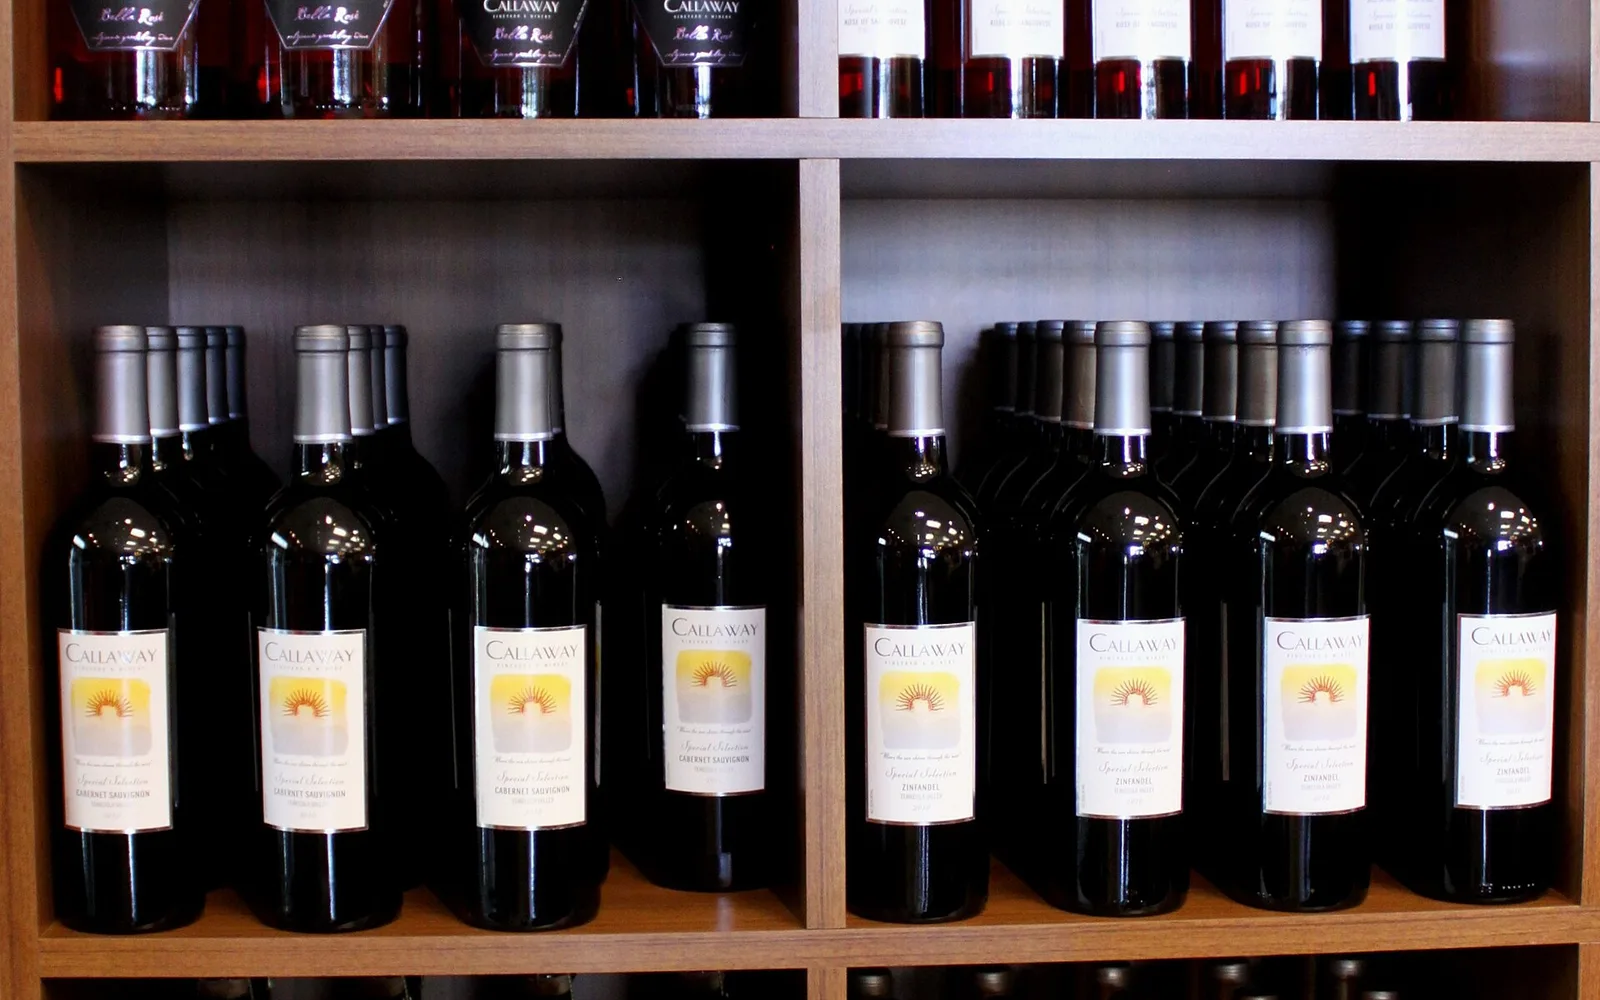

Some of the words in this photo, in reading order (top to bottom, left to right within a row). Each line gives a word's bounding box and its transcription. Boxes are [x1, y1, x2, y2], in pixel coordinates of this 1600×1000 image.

[483, 0, 559, 12] CALLAWAY
[663, 0, 739, 12] CALLAWAY
[672, 617, 757, 637] CALLAWAY
[1089, 633, 1176, 653] CALLAWAY
[1276, 630, 1362, 651] CALLAWAY
[265, 641, 354, 663] CALLAWAY
[486, 640, 578, 660] CALLAWAY
[874, 637, 966, 657] CALLAWAY
[65, 643, 157, 664] CALLAWAY
[678, 755, 710, 764] CABERNET
[712, 755, 750, 764] SAUVIGNON
[885, 766, 918, 780] Special
[1496, 766, 1529, 776] ZINFANDEL
[1115, 777, 1152, 786] ZINFANDEL
[1303, 773, 1340, 783] ZINFANDEL
[274, 787, 303, 799] CABERNET
[305, 789, 346, 799] SAUVIGNON
[494, 785, 528, 796] CABERNET
[531, 785, 570, 796] SAUVIGNON
[901, 783, 941, 792] ZINFANDEL
[76, 789, 106, 799] CABERNET
[108, 790, 150, 800] SAUVIGNON
